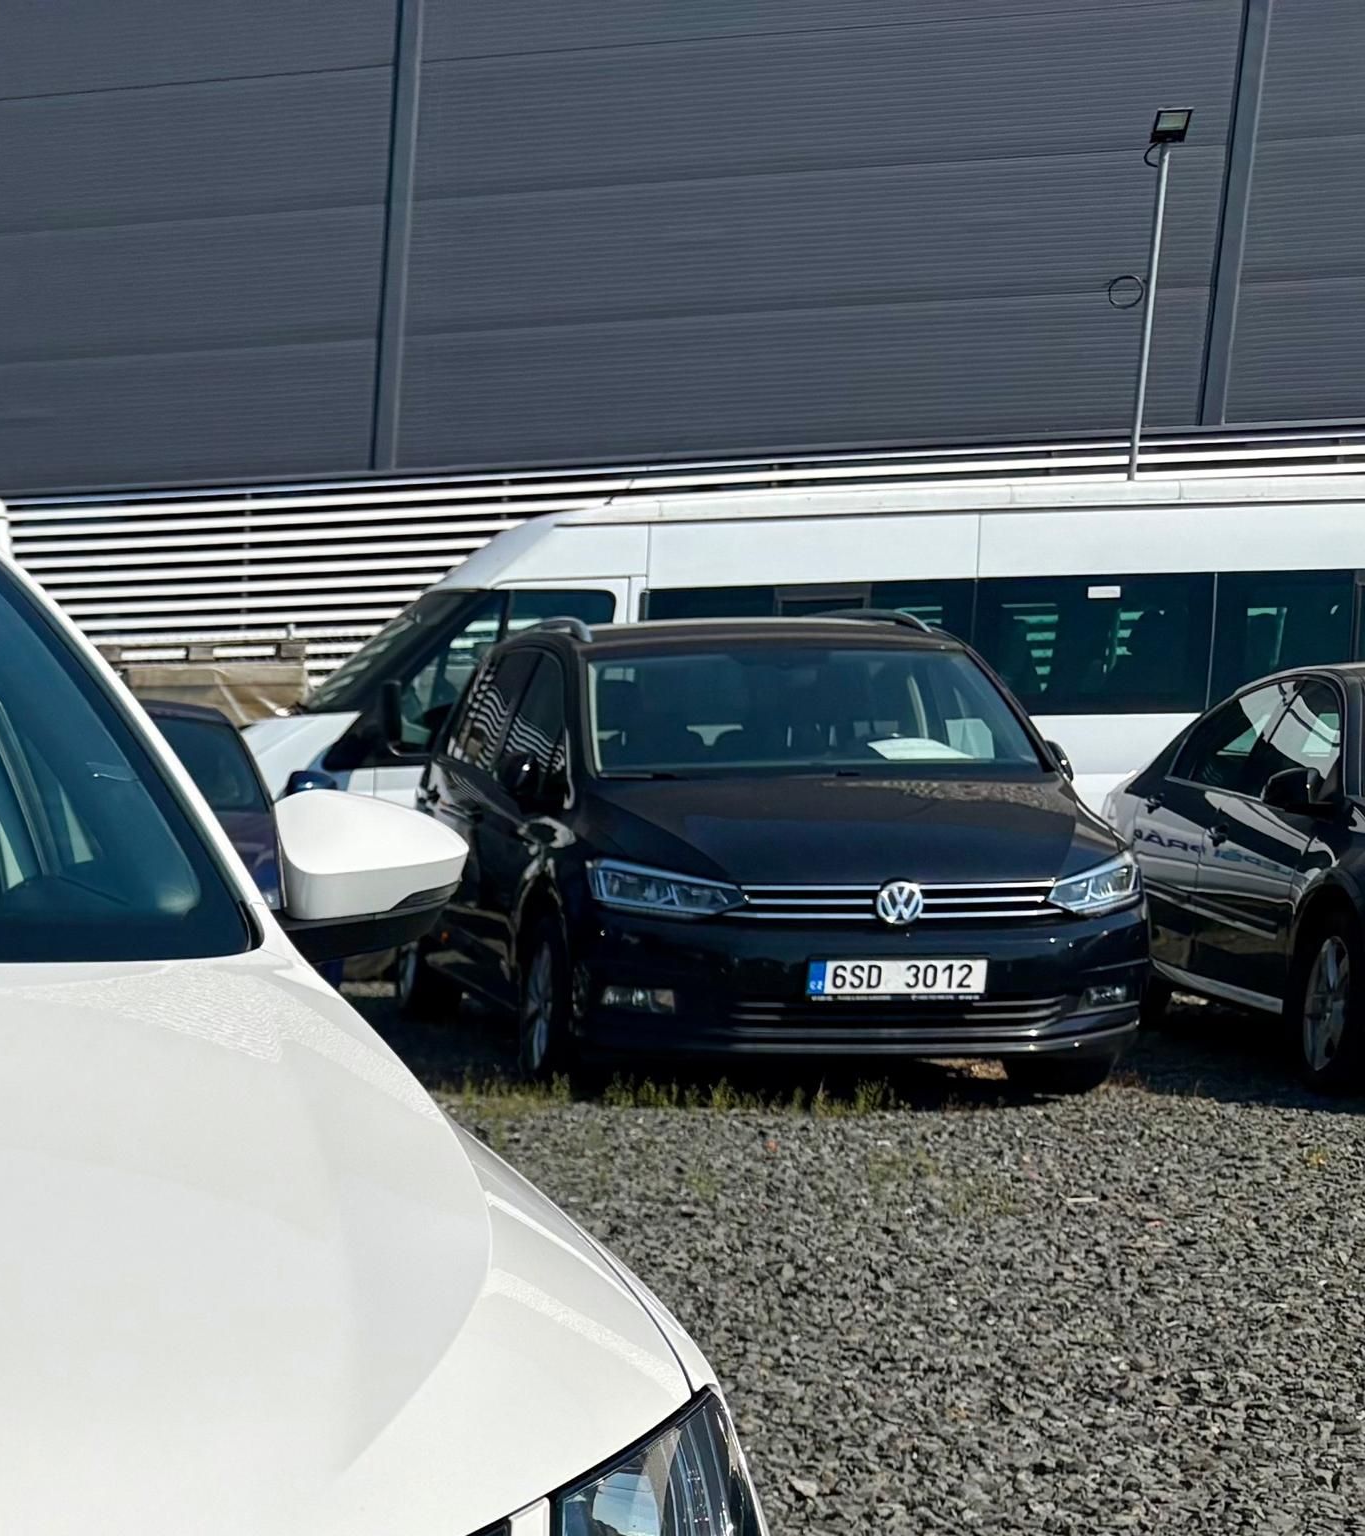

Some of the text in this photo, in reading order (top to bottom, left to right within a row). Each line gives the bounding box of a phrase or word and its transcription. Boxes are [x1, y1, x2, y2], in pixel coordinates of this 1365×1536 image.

[877, 881, 923, 924] VW
[832, 964, 973, 989] 6SD 3012
